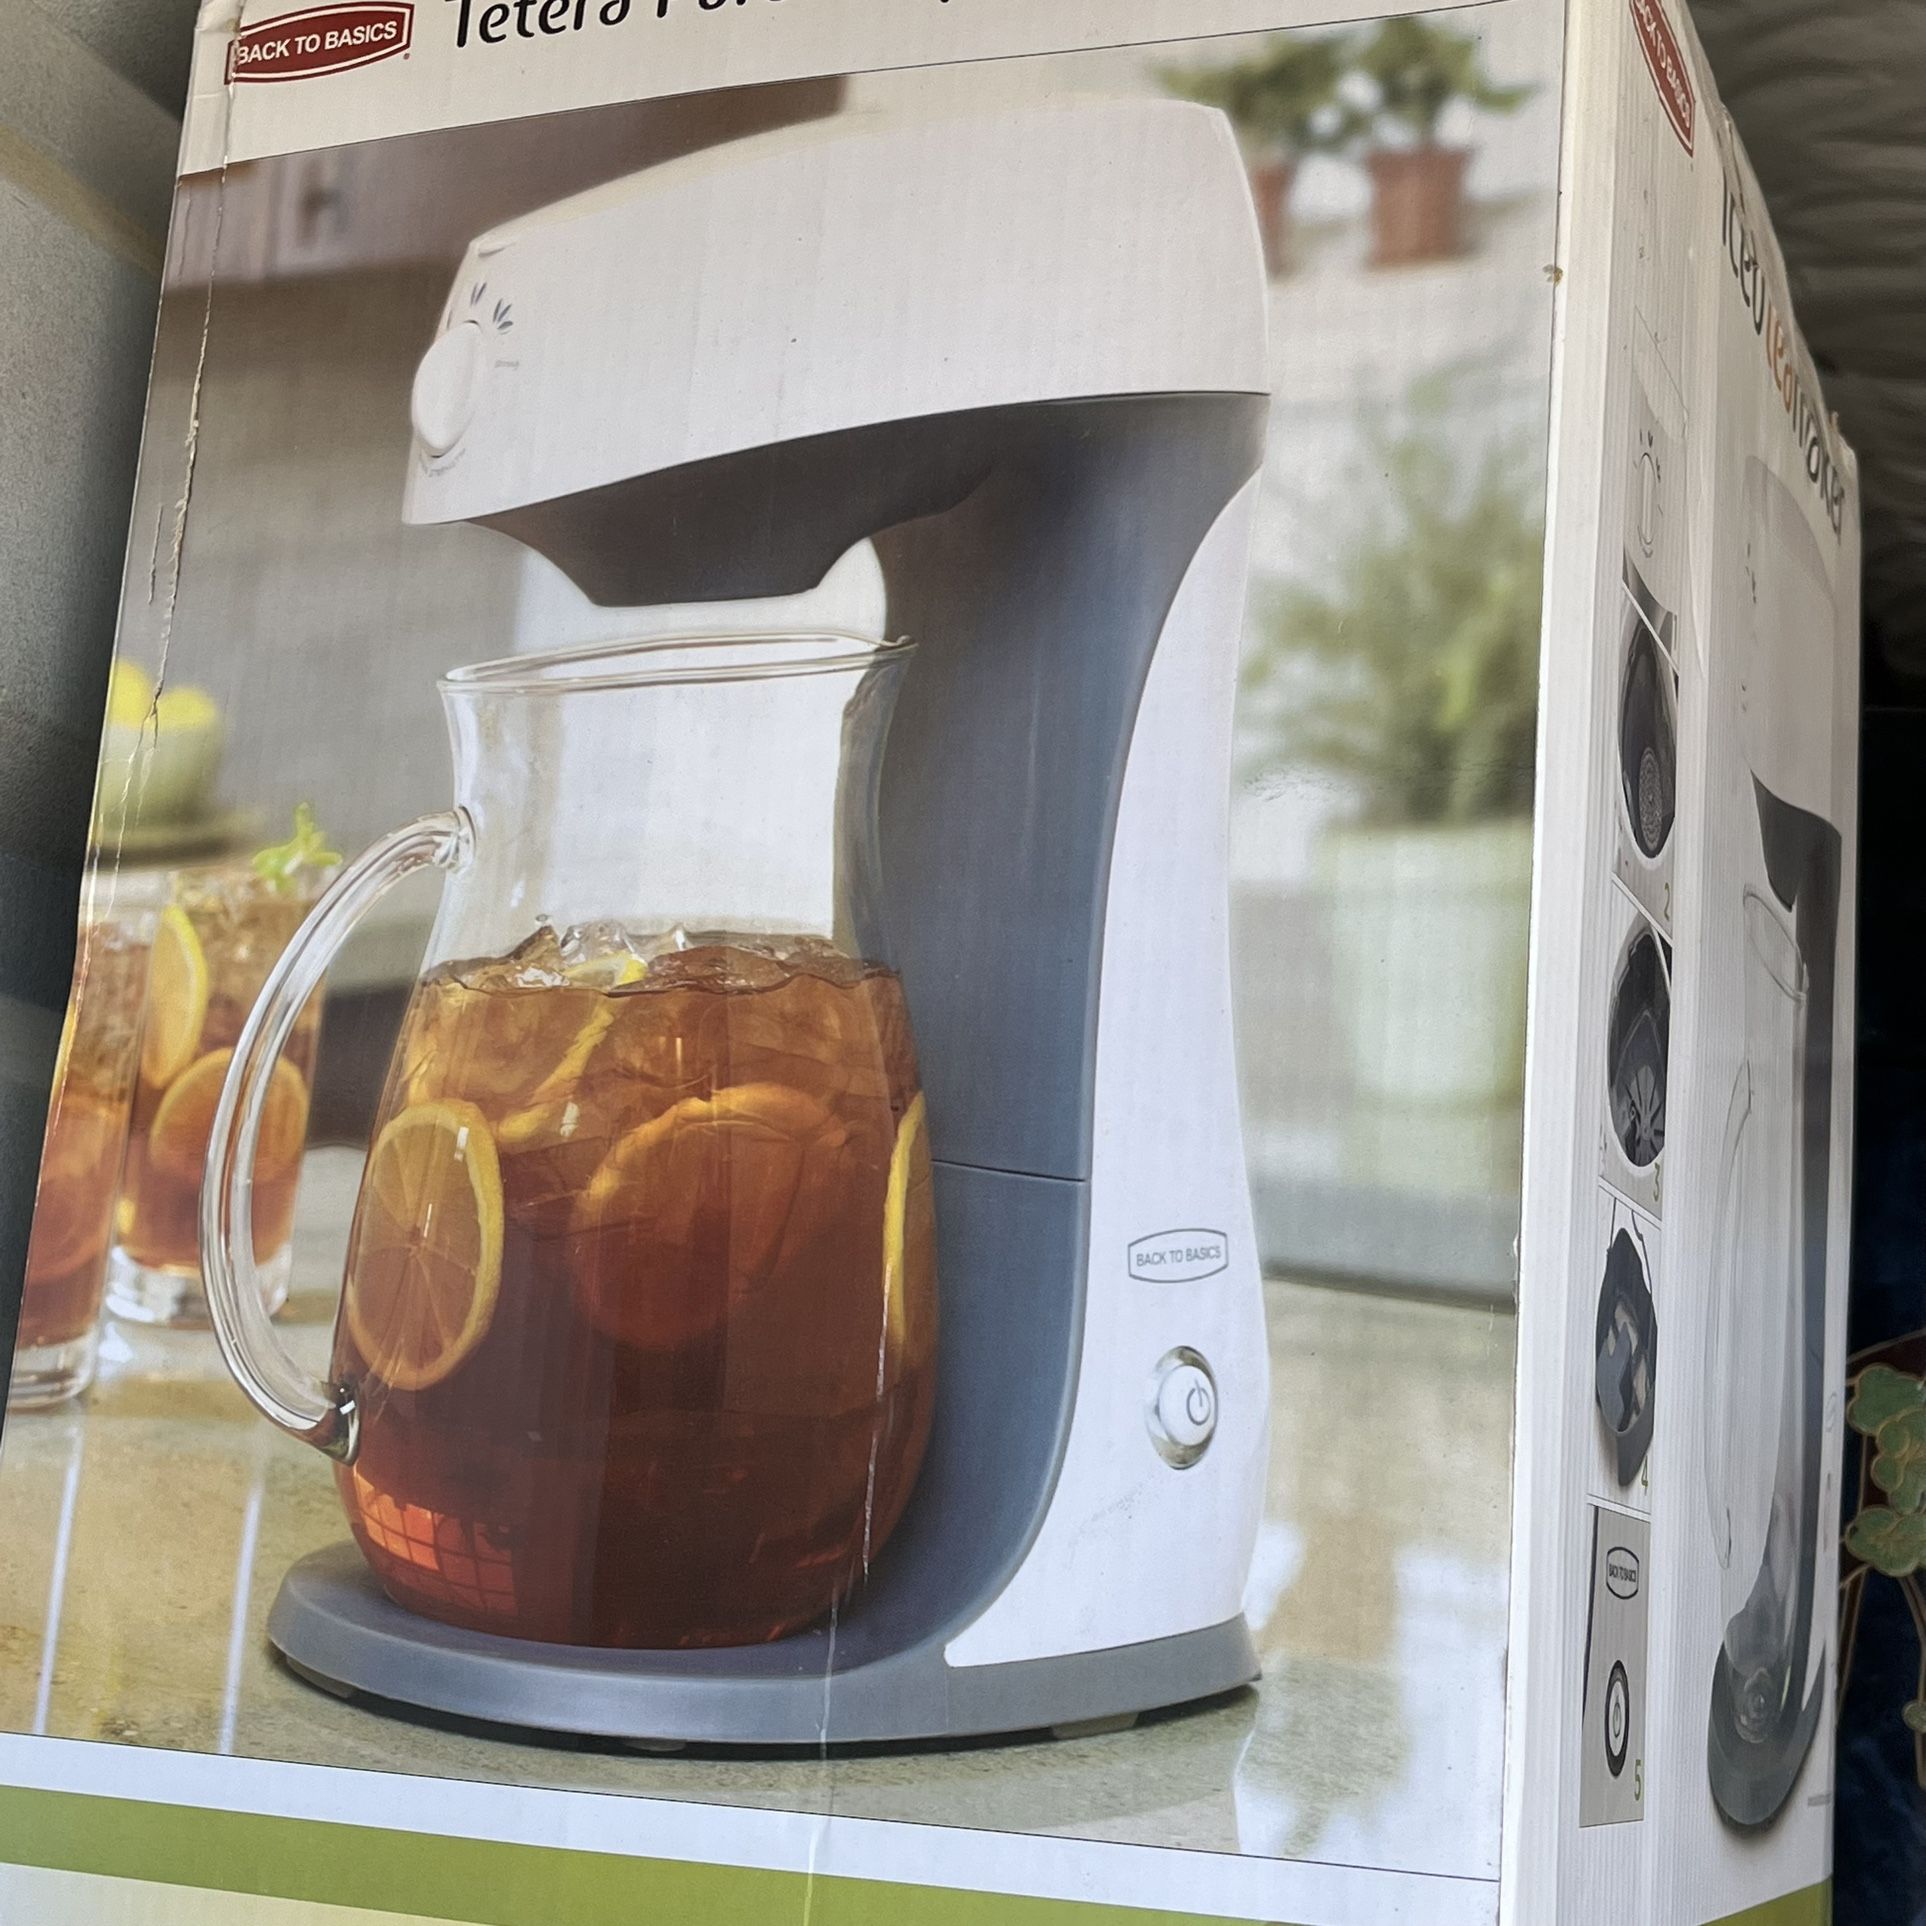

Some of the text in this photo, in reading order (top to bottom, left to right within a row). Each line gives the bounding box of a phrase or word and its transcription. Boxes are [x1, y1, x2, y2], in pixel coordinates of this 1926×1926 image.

[236, 20, 398, 65] BACK TO BASICS
[1135, 1245, 1222, 1268] BACK TO BASICS
[1634, 1758, 1642, 1801] 5
